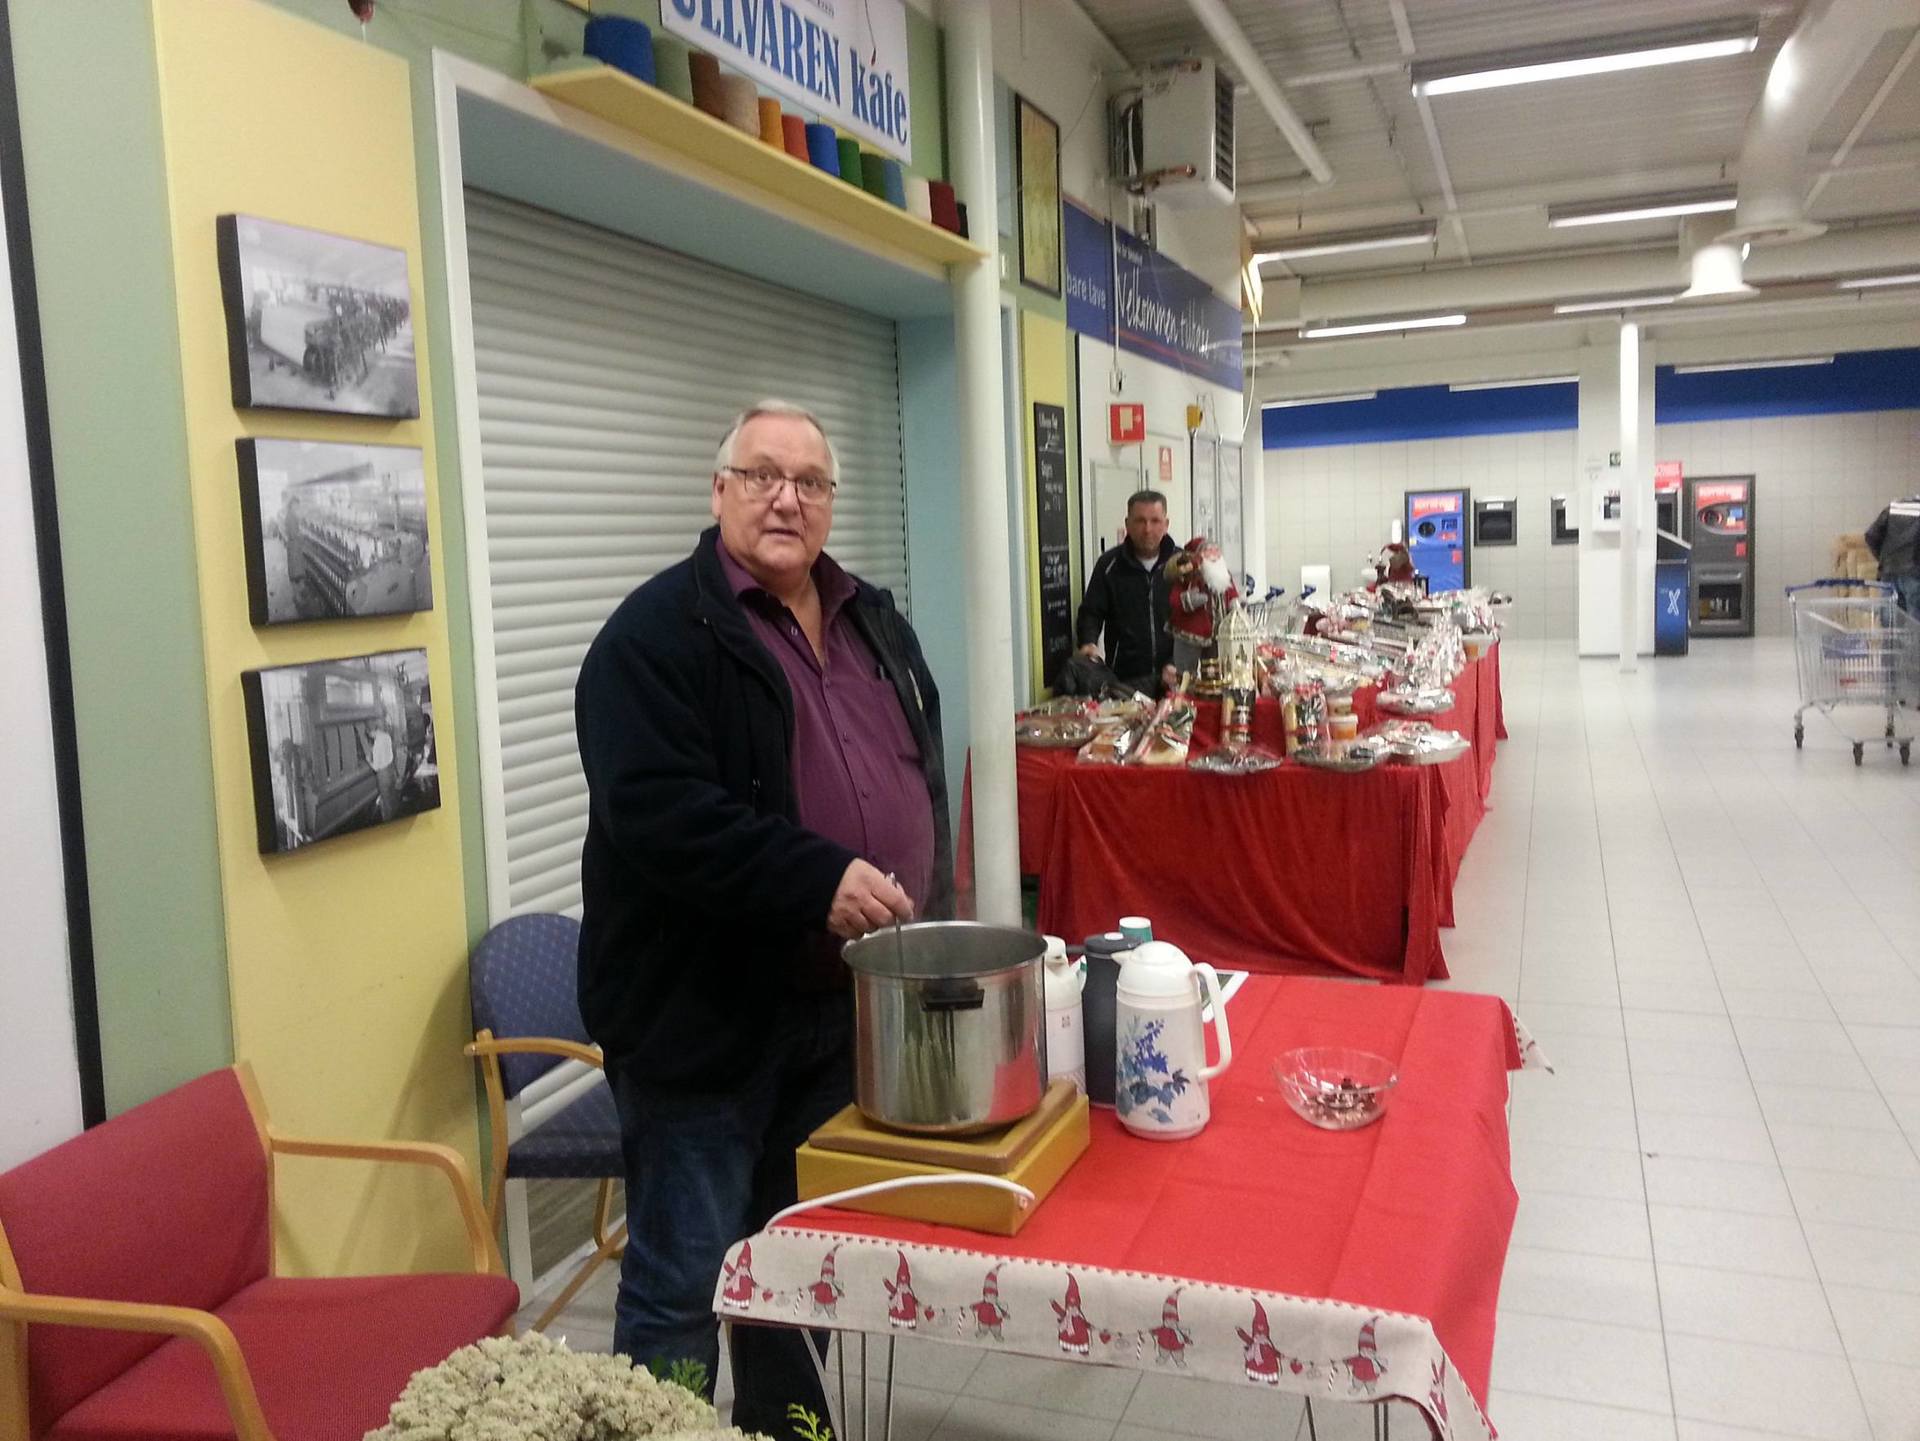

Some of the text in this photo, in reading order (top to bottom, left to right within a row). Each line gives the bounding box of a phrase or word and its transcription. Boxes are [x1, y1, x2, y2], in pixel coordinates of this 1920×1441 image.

[672, 0, 840, 107] LLVAREN
[1066, 264, 1106, 310] bare lave
[1117, 265, 1178, 344] Velkommen
